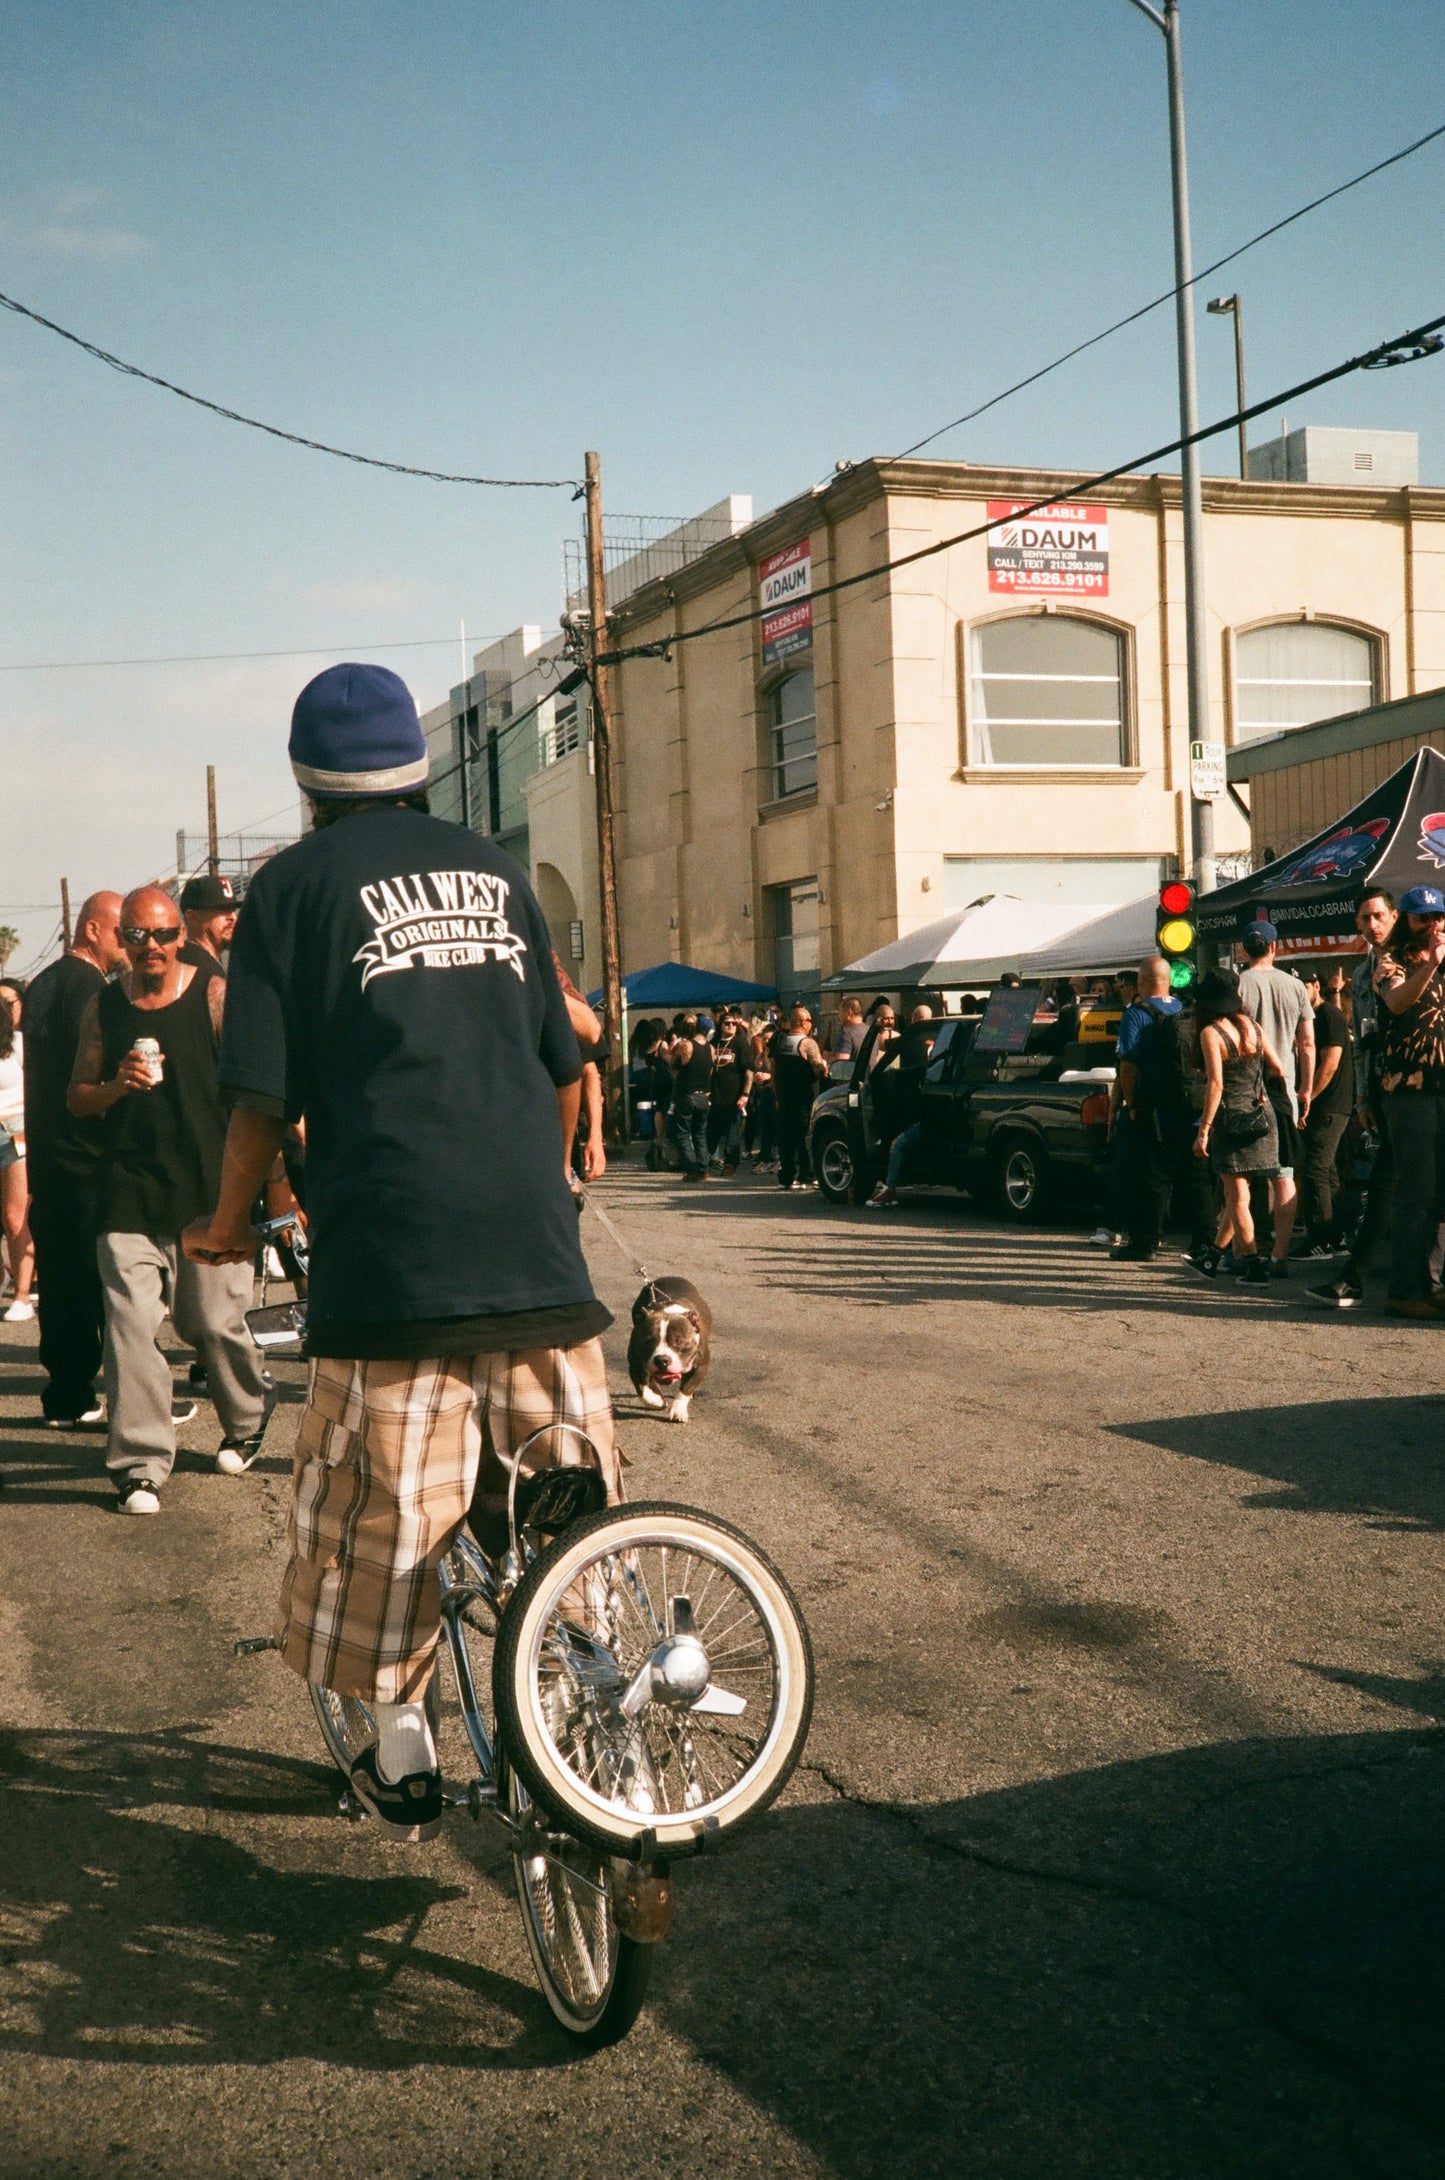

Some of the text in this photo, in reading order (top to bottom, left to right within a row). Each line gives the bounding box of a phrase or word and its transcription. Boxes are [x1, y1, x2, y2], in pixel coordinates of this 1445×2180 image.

[1010, 505, 1087, 519] AAILABLE
[1022, 528, 1097, 550] DAUM
[994, 558, 1017, 568] CALL
[1023, 560, 1044, 569] TEXT
[773, 566, 807, 599] DAUM
[996, 571, 1103, 587] 213.626.9101
[1194, 761, 1224, 772] PARKING
[360, 871, 510, 925] CALI WEST
[1424, 890, 1436, 904] LA
[390, 919, 506, 949] ORIGINALS
[422, 948, 486, 967] BIKE CLUB
